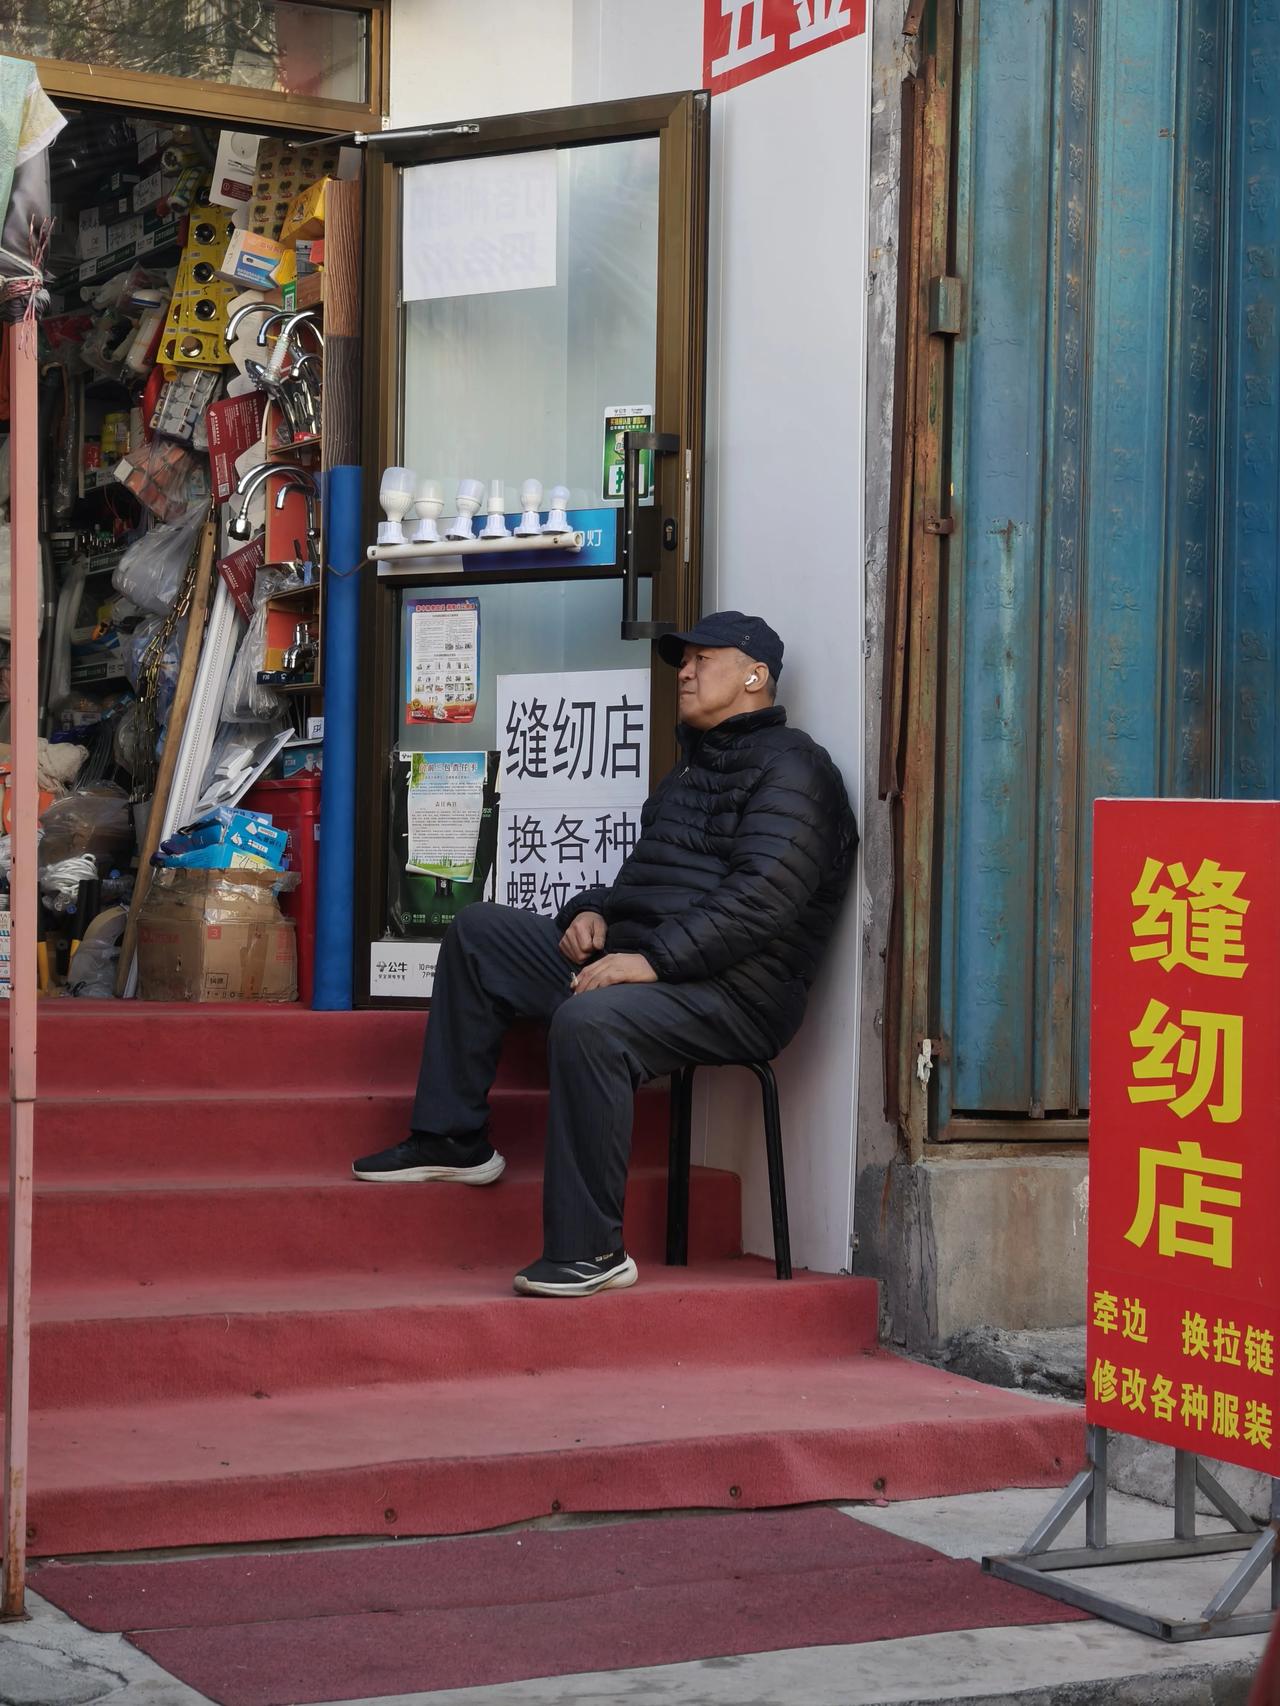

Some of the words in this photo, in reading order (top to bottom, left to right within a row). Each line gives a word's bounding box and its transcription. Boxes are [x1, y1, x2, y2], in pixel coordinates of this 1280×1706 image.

[506, 694, 644, 781] 缝纫店
[507, 811, 637, 864] 换各种
[388, 961, 408, 973] 公牛
[1124, 857, 1251, 1269] 缝纫店
[1094, 1290, 1149, 1344] 牵边
[1181, 1310, 1275, 1376] 换拉链
[1091, 1357, 1273, 1450] 修改各种服装
